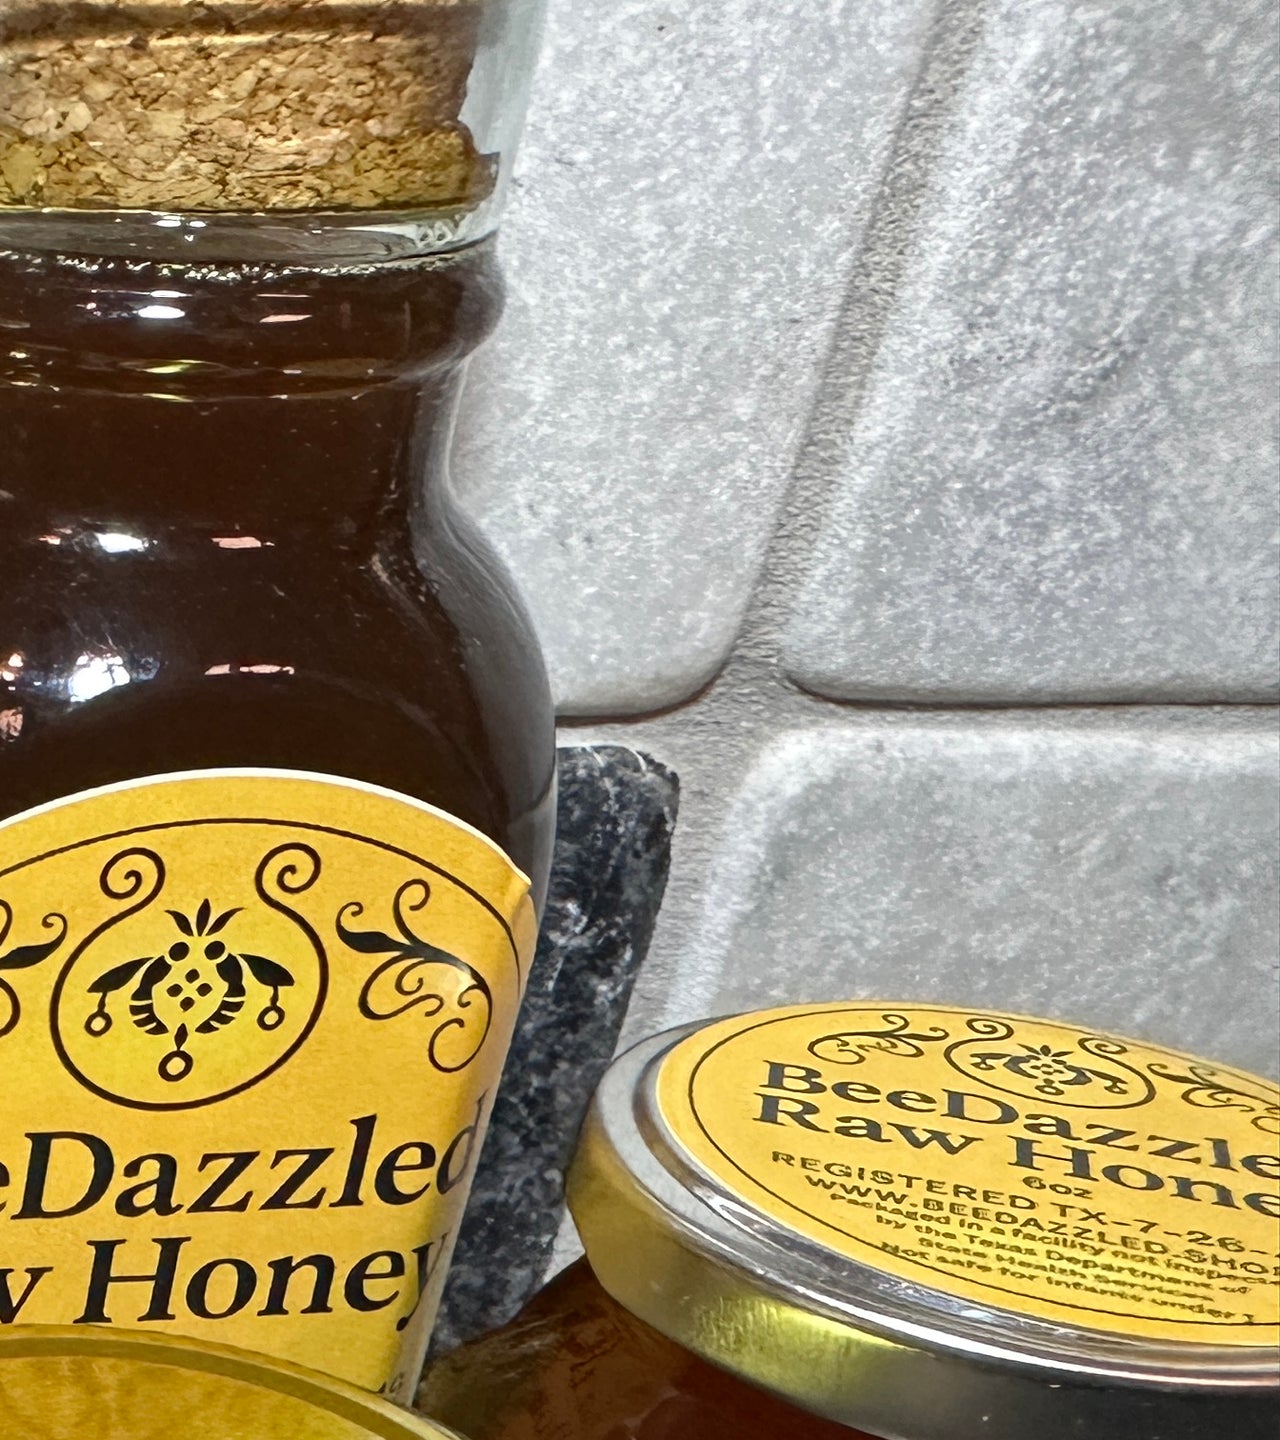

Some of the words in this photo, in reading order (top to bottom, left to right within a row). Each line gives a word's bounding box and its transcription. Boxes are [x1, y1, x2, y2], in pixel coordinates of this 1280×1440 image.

[753, 1092, 983, 1156] Raw
[1007, 1134, 1280, 1219] Hone
[760, 1060, 1280, 1177] BeeDazzle
[772, 1151, 1037, 1210] REGISTERED
[1050, 1201, 1280, 1258] TX-7-26-
[73, 1232, 448, 1331] Honey
